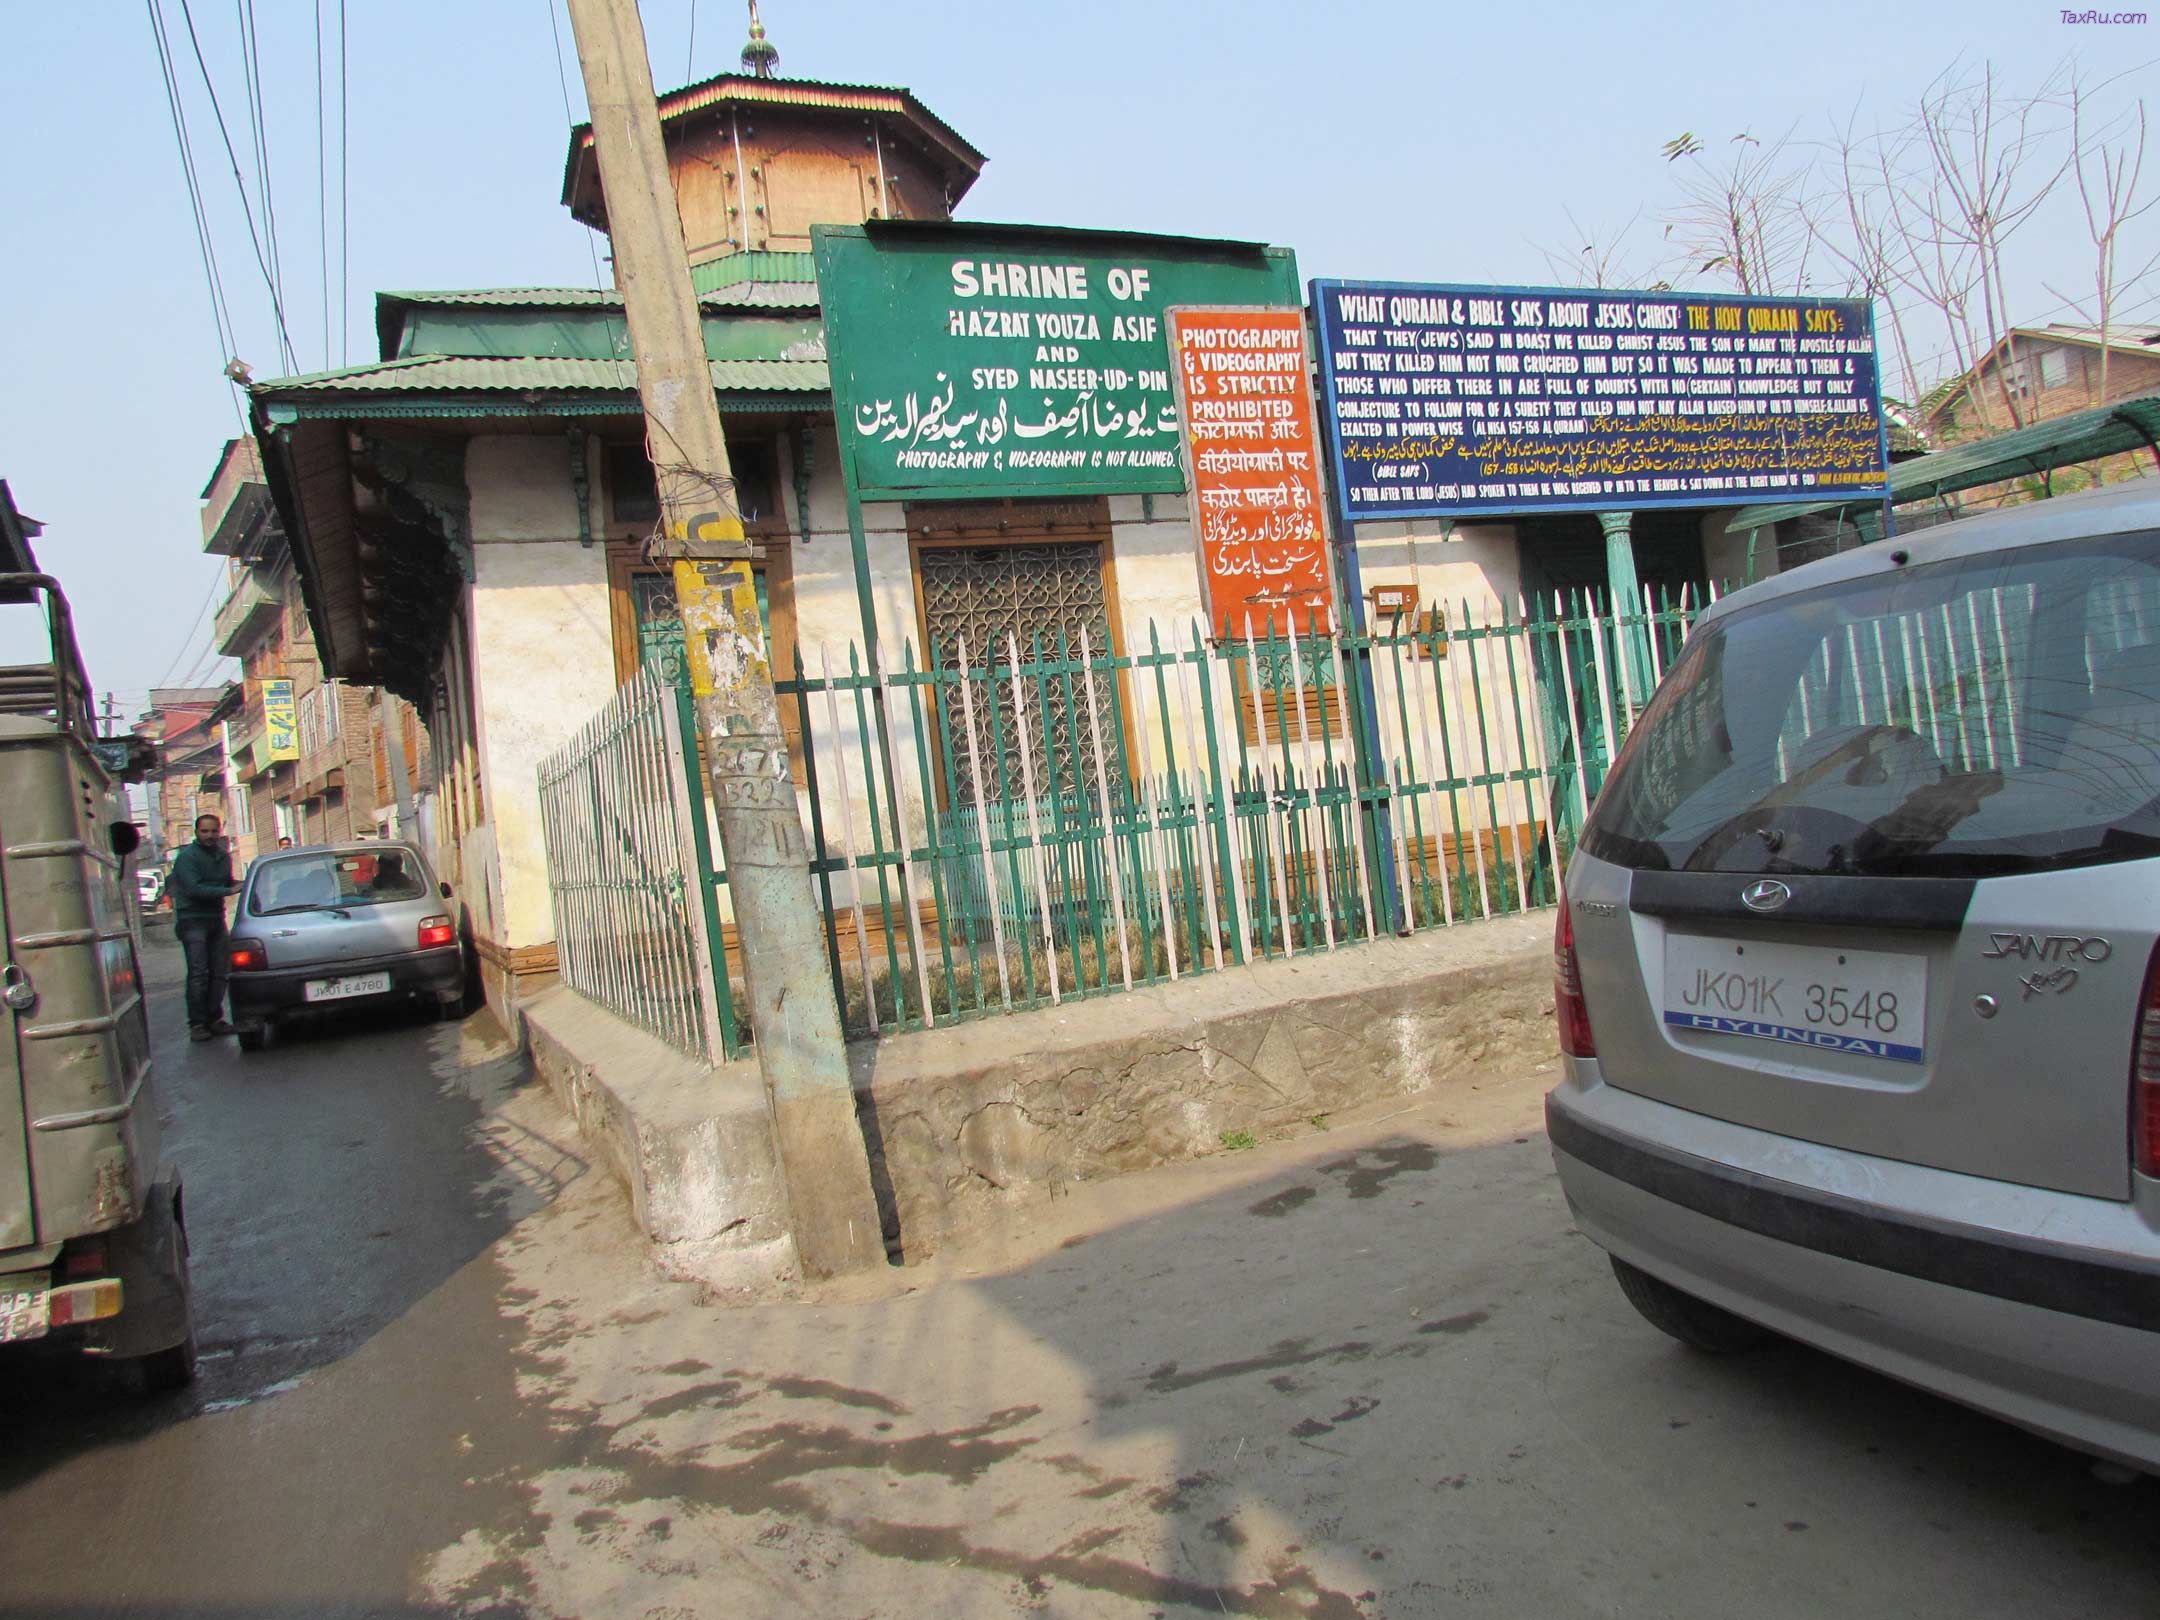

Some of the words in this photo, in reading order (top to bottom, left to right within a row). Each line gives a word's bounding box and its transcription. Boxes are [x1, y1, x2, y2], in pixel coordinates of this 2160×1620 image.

[951, 261, 1088, 299] SHRINE
[1107, 268, 1150, 301] OF
[1338, 295, 1385, 323] WHAT
[1391, 297, 1449, 327] QURAAN
[1451, 299, 1465, 325] &
[1468, 300, 1504, 326] BIBLE
[1511, 300, 1543, 327] SAYS
[1548, 302, 1589, 328] ABOUT
[1594, 303, 1633, 329] JESUS
[1686, 305, 1710, 330] THE
[1714, 306, 1742, 331] HOLY
[1748, 308, 1798, 333] QURAAN
[949, 310, 1030, 338] HAZRAT
[1035, 313, 1101, 341] YOUZA
[1112, 316, 1157, 342] ASIF
[1181, 328, 1300, 349] PHOTOGRAPHY
[1343, 329, 1377, 346] THAT
[1466, 332, 1494, 349] SAID
[1500, 333, 1512, 349] IN
[1516, 333, 1551, 350] BOAST
[1554, 334, 1573, 350] WE
[1577, 334, 1613, 350] KILLED
[1616, 335, 1653, 351] CHRIST
[1656, 335, 1686, 351] JESUS
[1689, 336, 1708, 352] THE
[1711, 337, 1731, 352] SON
[1734, 338, 1745, 352] OF
[1748, 338, 1777, 352] MARY
[1779, 338, 1796, 353] THE
[1800, 338, 1834, 353] APOSTLE
[1835, 339, 1846, 353] OF
[1847, 339, 1872, 354] ALLAH
[1036, 346, 1080, 363] AND
[1184, 352, 1195, 375] &
[1199, 352, 1302, 372] VIDEOGRAPHY
[1335, 352, 1359, 371] BUT
[1361, 353, 1391, 372] THEY
[1395, 353, 1435, 373] KILLED
[1438, 355, 1463, 373] HIM
[1466, 355, 1490, 373] NOT
[1496, 355, 1520, 373] NOR
[1523, 355, 1579, 373] CRUCIFIED
[1583, 356, 1607, 374] HIM
[1611, 356, 1634, 373] BUT
[1638, 356, 1653, 374] SO
[1658, 356, 1668, 373] IT
[1672, 357, 1697, 374] WAS
[1703, 358, 1735, 374] MADE
[1738, 358, 1752, 374] TO
[1755, 358, 1793, 375] APPEAR
[1795, 358, 1808, 375] TO
[1810, 358, 1840, 375] THEM
[1844, 358, 1854, 374] &
[972, 368, 1019, 391] SYED
[1190, 376, 1207, 395] IS
[1217, 375, 1297, 395] STRICTLY
[1335, 377, 1374, 394] THOSE
[1379, 378, 1407, 394] WHO
[1412, 378, 1451, 395] DIFFER
[1456, 378, 1493, 395] THERE
[1499, 379, 1512, 395] IN
[1518, 379, 1541, 395] ARE
[1547, 379, 1573, 395] FULL
[1576, 379, 1590, 395] OF
[1595, 378, 1637, 395] DOUBTS
[1640, 378, 1669, 395] WITH
[1738, 379, 1799, 395] KNOWLEDGE
[1803, 380, 1822, 394] BUT
[1827, 379, 1854, 394] ONLY
[976, 396, 1007, 445] اور
[1192, 400, 1294, 419] PROHIBITED
[1336, 401, 1400, 419] CONJECTURE
[1405, 402, 1420, 418] TO
[1424, 402, 1463, 418] FOLLOW
[1466, 402, 1485, 418] FOR
[1487, 402, 1500, 418] OF
[1503, 402, 1512, 418] A
[1514, 401, 1551, 418] SURETY
[1553, 401, 1578, 417] THEY
[1581, 401, 1613, 417] KILLED
[1616, 400, 1636, 416] HIM
[1638, 400, 1657, 416] NOT
[1657, 400, 1676, 416] NAY
[1678, 399, 1705, 415] ALLAH
[1707, 399, 1737, 414] RAISED
[1738, 399, 1755, 414] HIM
[1755, 399, 1767, 414] UP
[1859, 399, 1868, 413] IS
[1270, 418, 1303, 440] और
[1340, 422, 1382, 437] EXALTED
[1386, 422, 1398, 437] IN
[1402, 422, 1436, 436] POWER
[1438, 422, 1464, 436] WISE
[1473, 419, 1487, 437] (AL
[1487, 421, 1506, 435] NISA
[1508, 420, 1539, 434] 157-158
[1542, 420, 1552, 434] AL
[1553, 417, 1588, 435] QURAAN)
[896, 451, 990, 469] PHOTOGRAPHY
[993, 451, 1003, 472] &
[1008, 450, 1087, 469] VIDEOGRAPHY
[1091, 451, 1103, 468] IS
[1106, 451, 1127, 468] NOT
[1286, 451, 1311, 471] पर
[1350, 487, 1360, 502] SO
[1361, 487, 1379, 502] THEN
[1380, 487, 1400, 501] AFTER
[1415, 486, 1434, 500] LORD
[1460, 485, 1476, 498] HAD
[1479, 485, 1505, 498] SPOKEN
[1518, 483, 1539, 496] THEM
[1552, 483, 1570, 495] WAS
[1572, 482, 1601, 495] RECEIVED
[1653, 479, 1679, 491] HEAVEN
[1689, 478, 1702, 490] SAT
[1702, 476, 1724, 489] DOWN
[1750, 475, 1768, 487] RIGHT
[1769, 474, 1788, 486] HAND
[1802, 473, 1815, 485] GOD
[1982, 932, 2112, 961] SANTRO
[1683, 968, 1785, 1018] JK01K
[1805, 984, 1898, 1033] 3548
[1692, 1015, 1887, 1056] HYUNDAI
